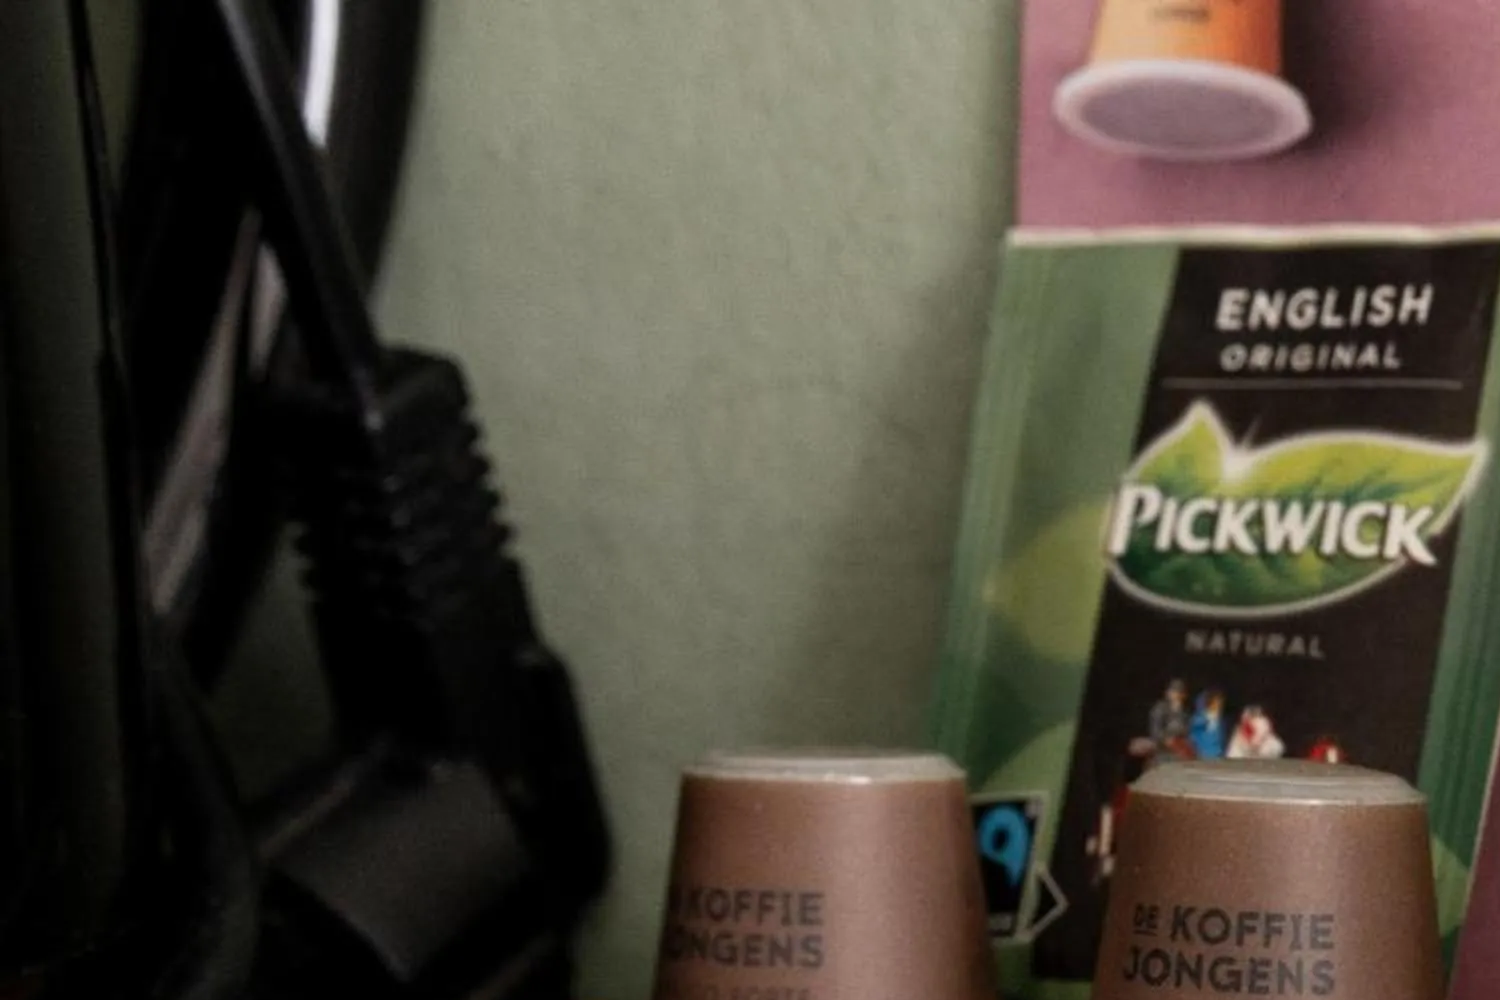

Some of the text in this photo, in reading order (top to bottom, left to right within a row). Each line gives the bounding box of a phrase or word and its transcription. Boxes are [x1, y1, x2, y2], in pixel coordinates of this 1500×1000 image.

[1215, 284, 1433, 331] ENGLISH
[1220, 344, 1402, 372] ORIGINAL
[1109, 481, 1437, 567] PICKWICK
[1186, 630, 1326, 659] NATURAL
[668, 926, 825, 969] ONGENS
[1169, 905, 1335, 950] KOFFIE
[1121, 945, 1337, 996] JONGENS
